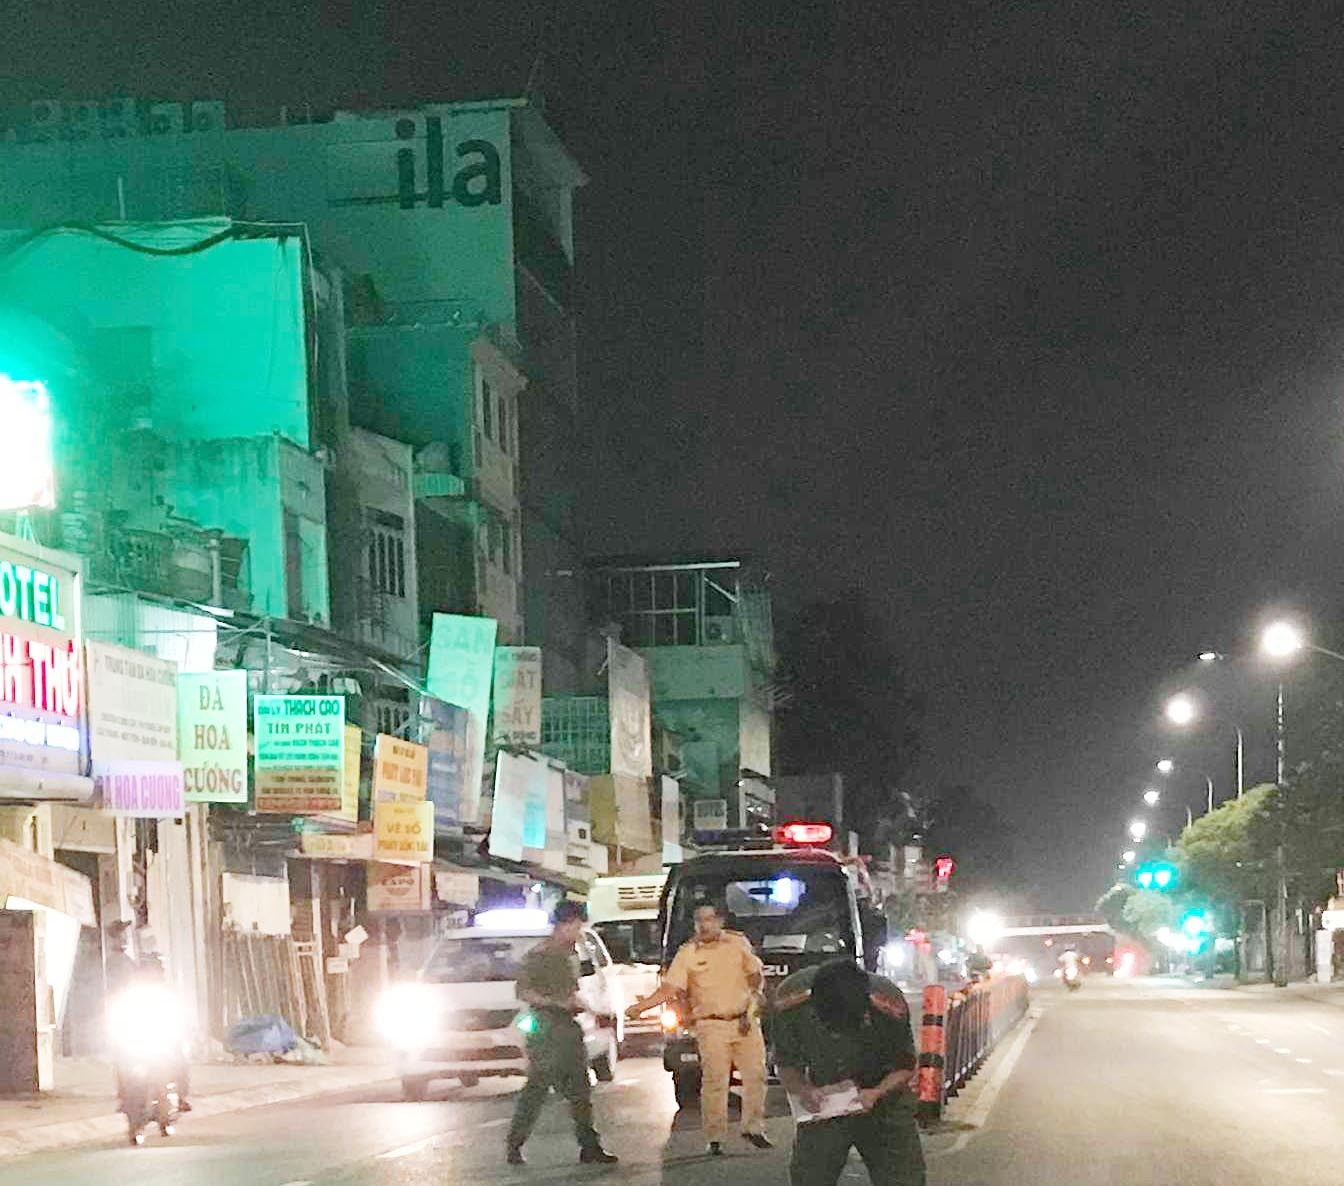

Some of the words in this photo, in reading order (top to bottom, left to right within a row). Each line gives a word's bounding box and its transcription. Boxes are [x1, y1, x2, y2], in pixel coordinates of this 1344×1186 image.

[395, 117, 502, 209] ila
[194, 724, 230, 750] HOA
[114, 774, 138, 810] HOA
[762, 964, 788, 976] ZU
